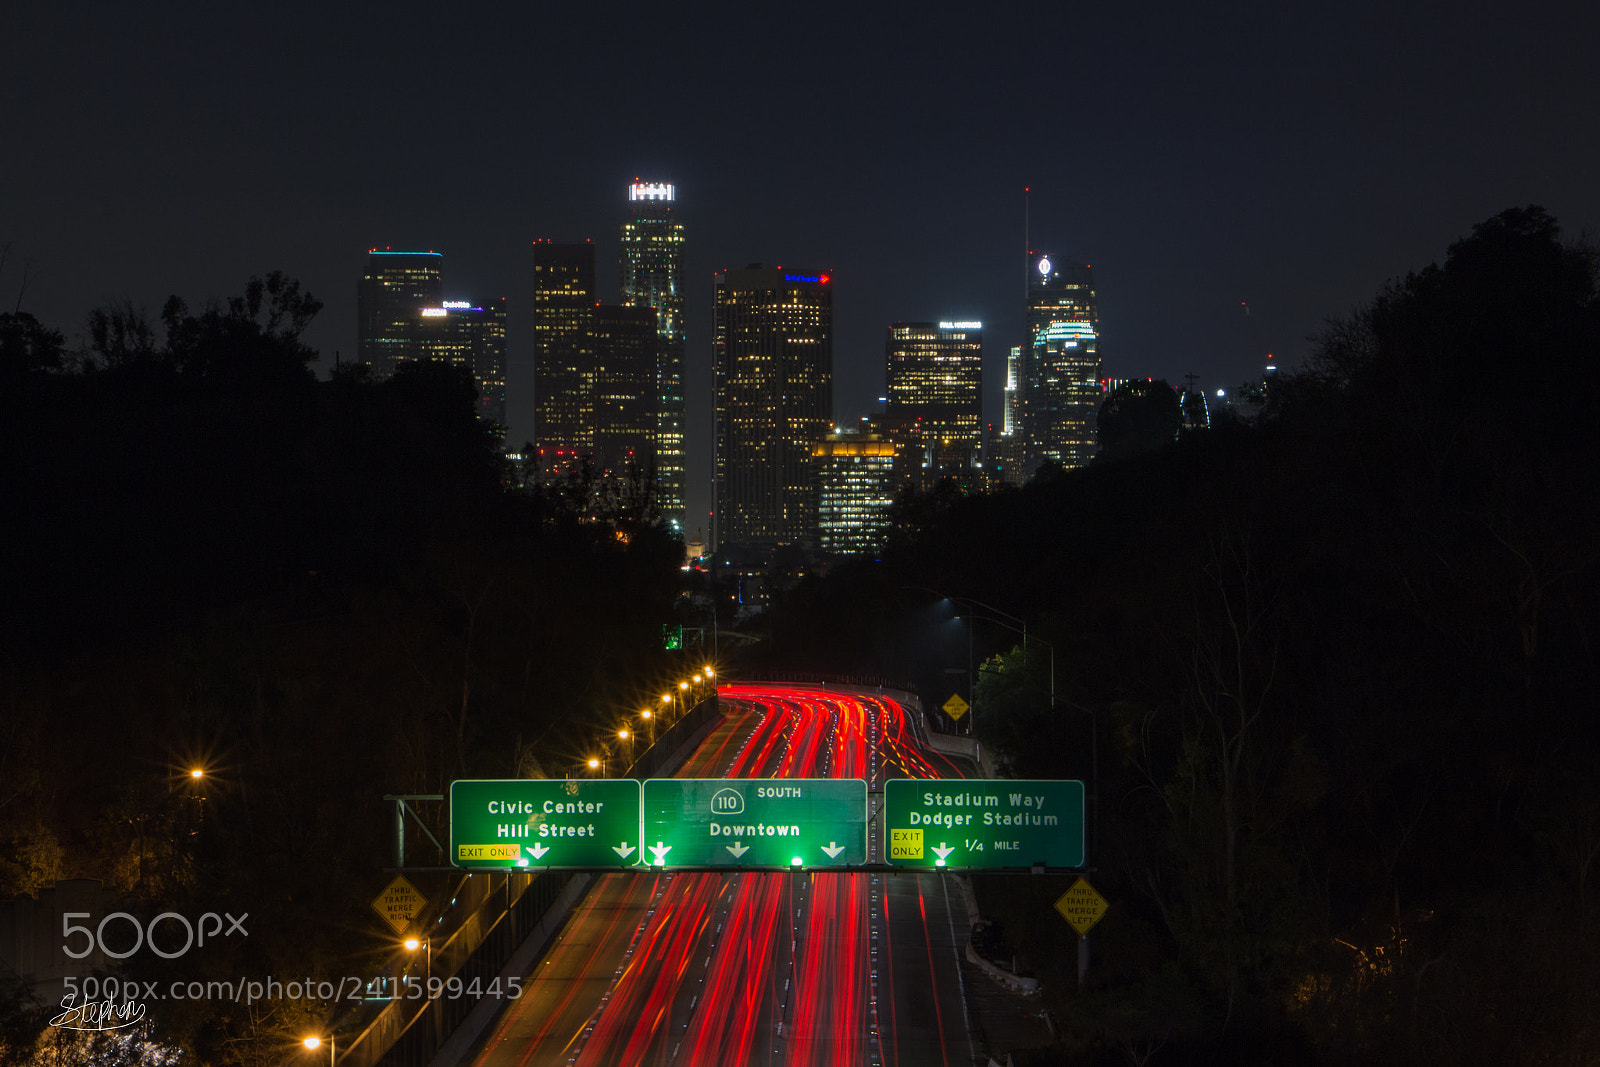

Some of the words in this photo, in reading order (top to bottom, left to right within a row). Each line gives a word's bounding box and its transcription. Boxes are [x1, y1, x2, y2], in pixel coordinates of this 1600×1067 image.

[757, 786, 802, 798] SOUTH
[488, 801, 533, 814] Civic
[543, 800, 604, 814] Center
[718, 797, 737, 809] 110
[924, 793, 999, 807] Stadium
[1009, 793, 1045, 810] Way
[910, 812, 973, 829] Dodger
[983, 812, 1058, 826] Stadium
[497, 824, 529, 838] Hill
[538, 823, 595, 837] Street
[710, 823, 800, 836] Downtown
[893, 832, 921, 841] EXIT
[965, 838, 984, 852] 1/4
[994, 841, 1020, 850] MILE
[460, 848, 484, 857] EXIT
[490, 847, 518, 857] ONLY
[892, 847, 921, 856] ONLY
[385, 895, 417, 903] TRAFFIC
[387, 904, 414, 912] MERGE
[1068, 907, 1098, 915] MERGE
